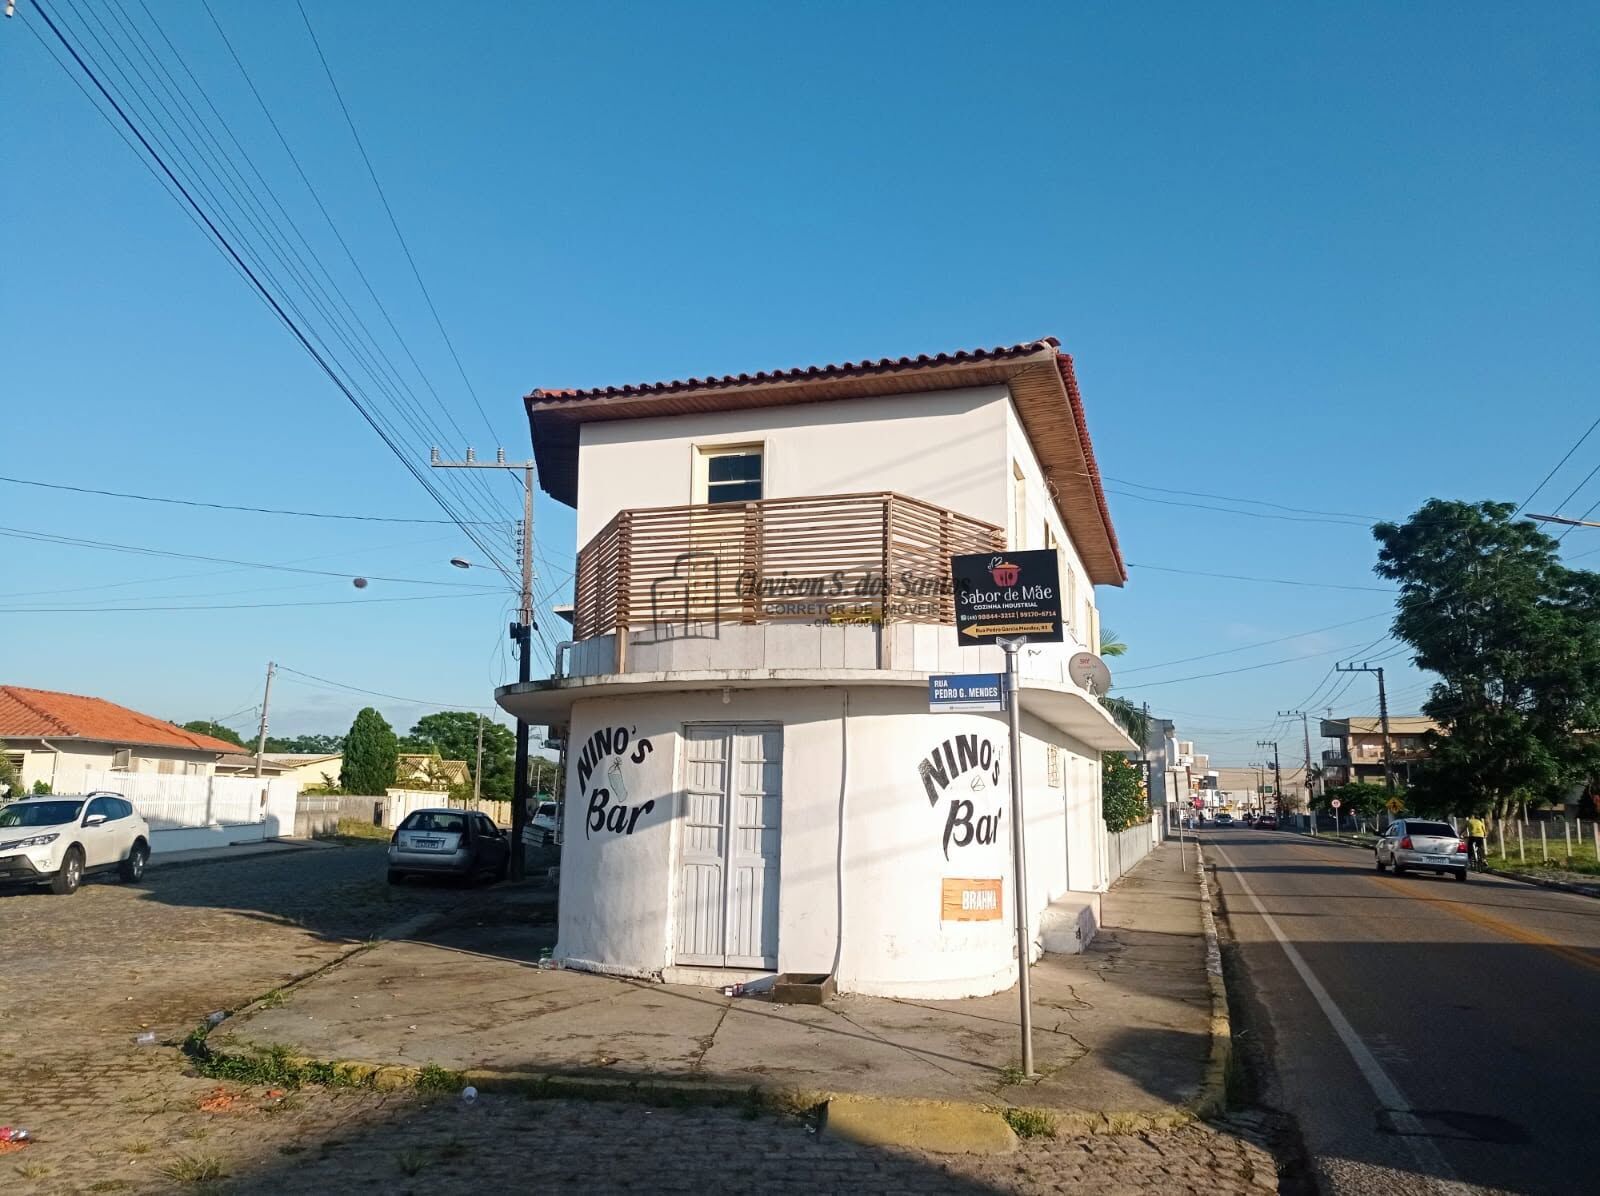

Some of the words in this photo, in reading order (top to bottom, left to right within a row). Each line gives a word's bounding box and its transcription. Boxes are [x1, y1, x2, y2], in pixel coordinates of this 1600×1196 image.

[960, 588, 1001, 605] Sabor
[1003, 587, 1019, 601] de
[1022, 585, 1053, 600] Mãe
[934, 680, 948, 688] RUA
[934, 688, 958, 699] PEDRO
[959, 688, 967, 698] G.
[968, 687, 998, 698] MENDES
[577, 725, 654, 797] NINO'S
[918, 734, 1001, 808] NINO'S
[586, 788, 655, 840] Bar
[943, 799, 1002, 862] Bar
